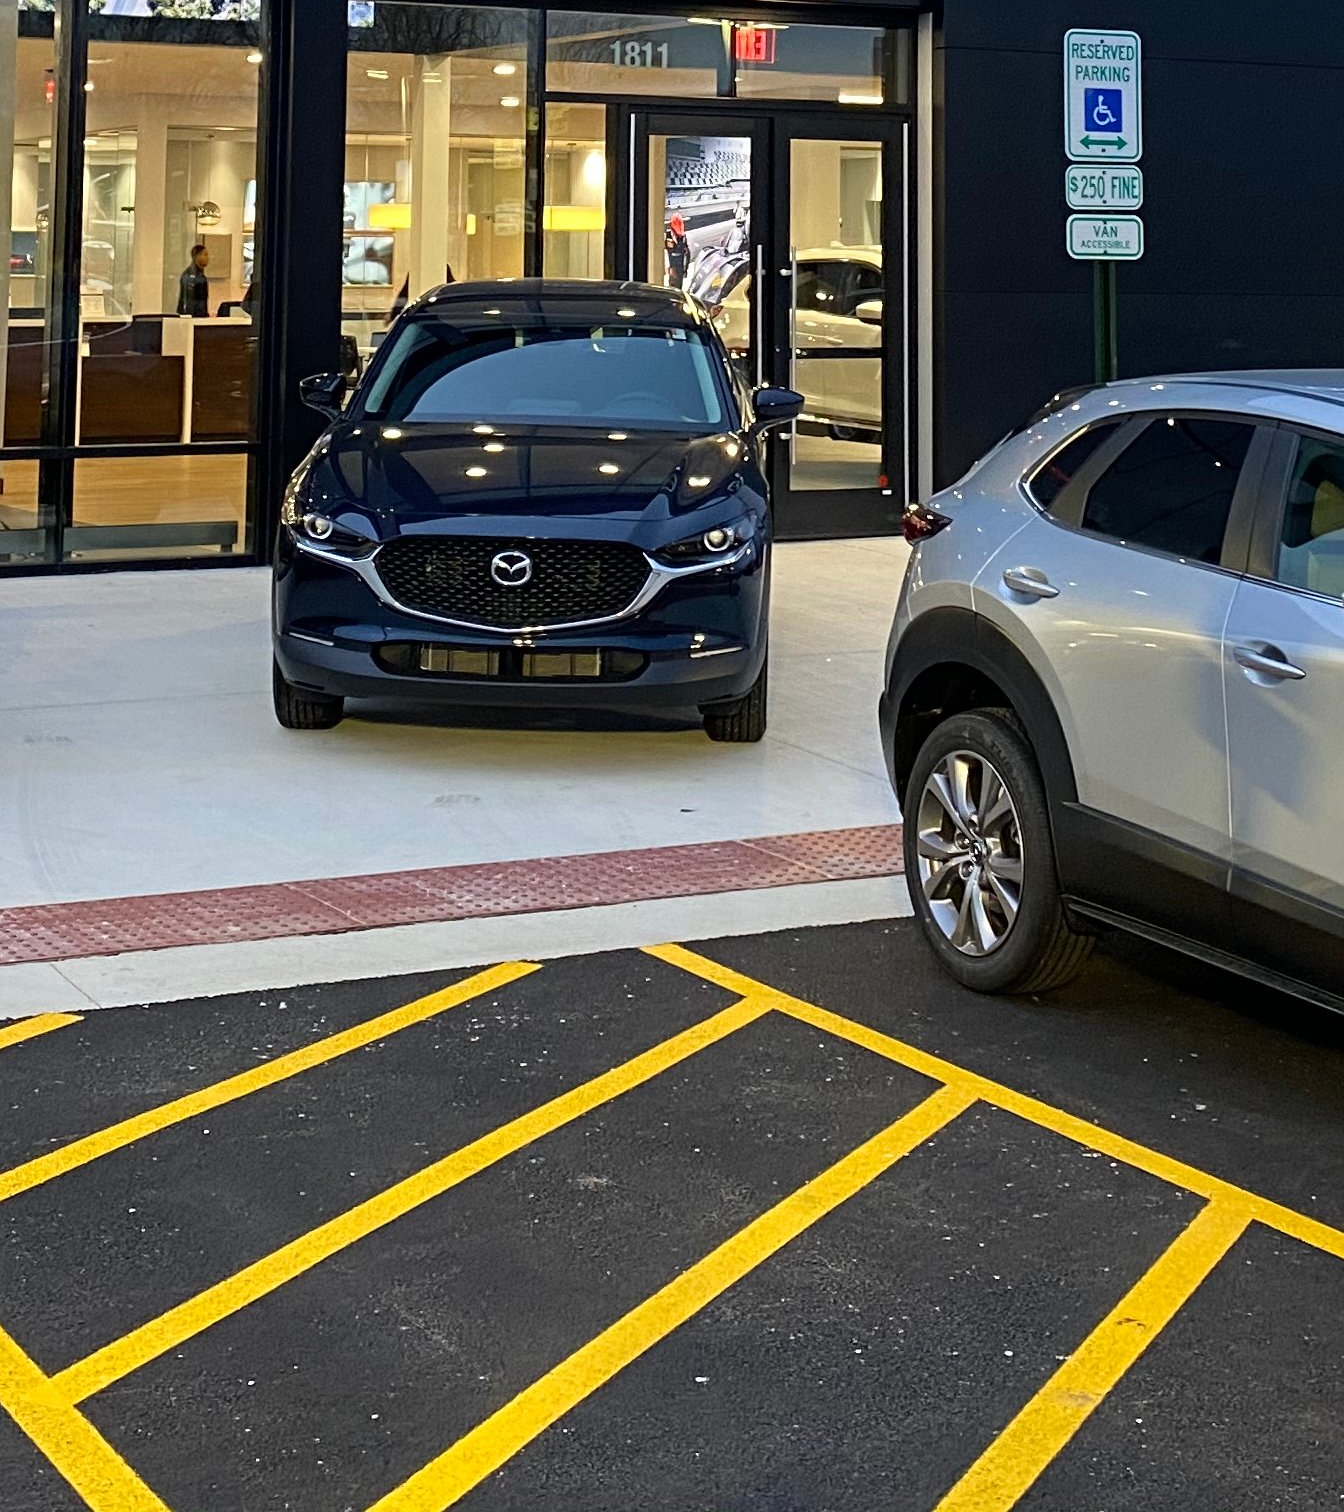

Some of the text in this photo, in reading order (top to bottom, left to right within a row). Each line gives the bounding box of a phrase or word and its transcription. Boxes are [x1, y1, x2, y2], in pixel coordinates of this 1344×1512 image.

[610, 40, 669, 69] 1811
[1071, 43, 1135, 61] RESERVED
[1075, 65, 1130, 82] PARKING
[1070, 175, 1139, 199] $250 FINE
[1093, 225, 1118, 238] VAN
[1080, 240, 1131, 249] ACCESSIBLE
